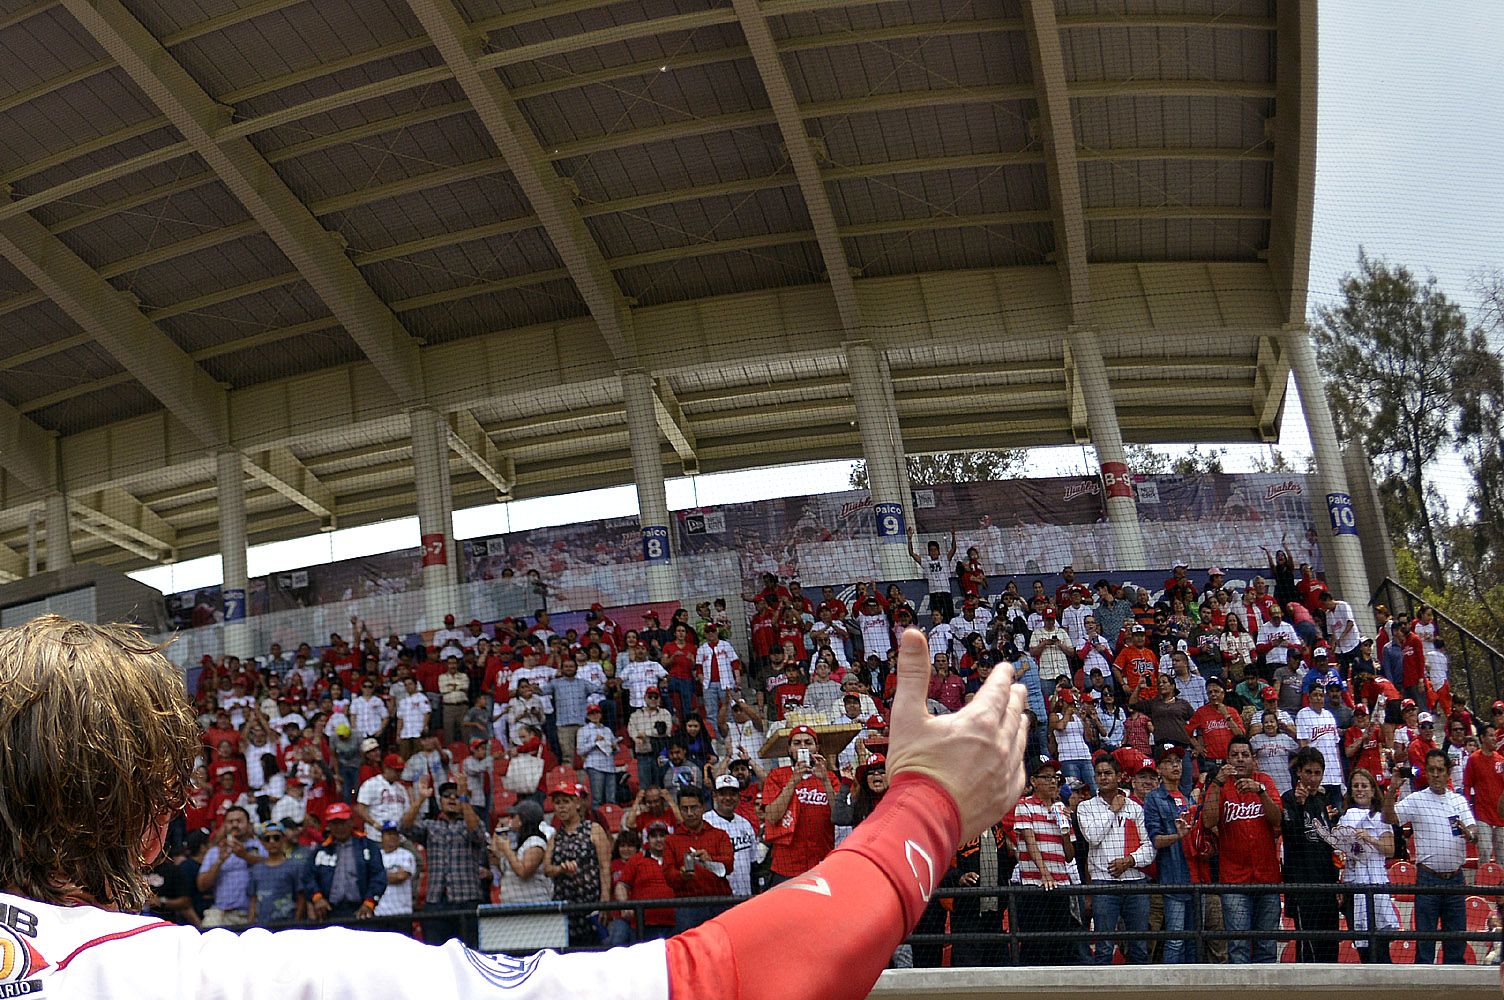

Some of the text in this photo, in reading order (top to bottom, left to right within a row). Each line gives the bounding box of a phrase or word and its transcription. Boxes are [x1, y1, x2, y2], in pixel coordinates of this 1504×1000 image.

[883, 515, 899, 535] 9
[1331, 507, 1356, 527] 10
[647, 539, 663, 558] 8
[224, 600, 239, 619] 7
